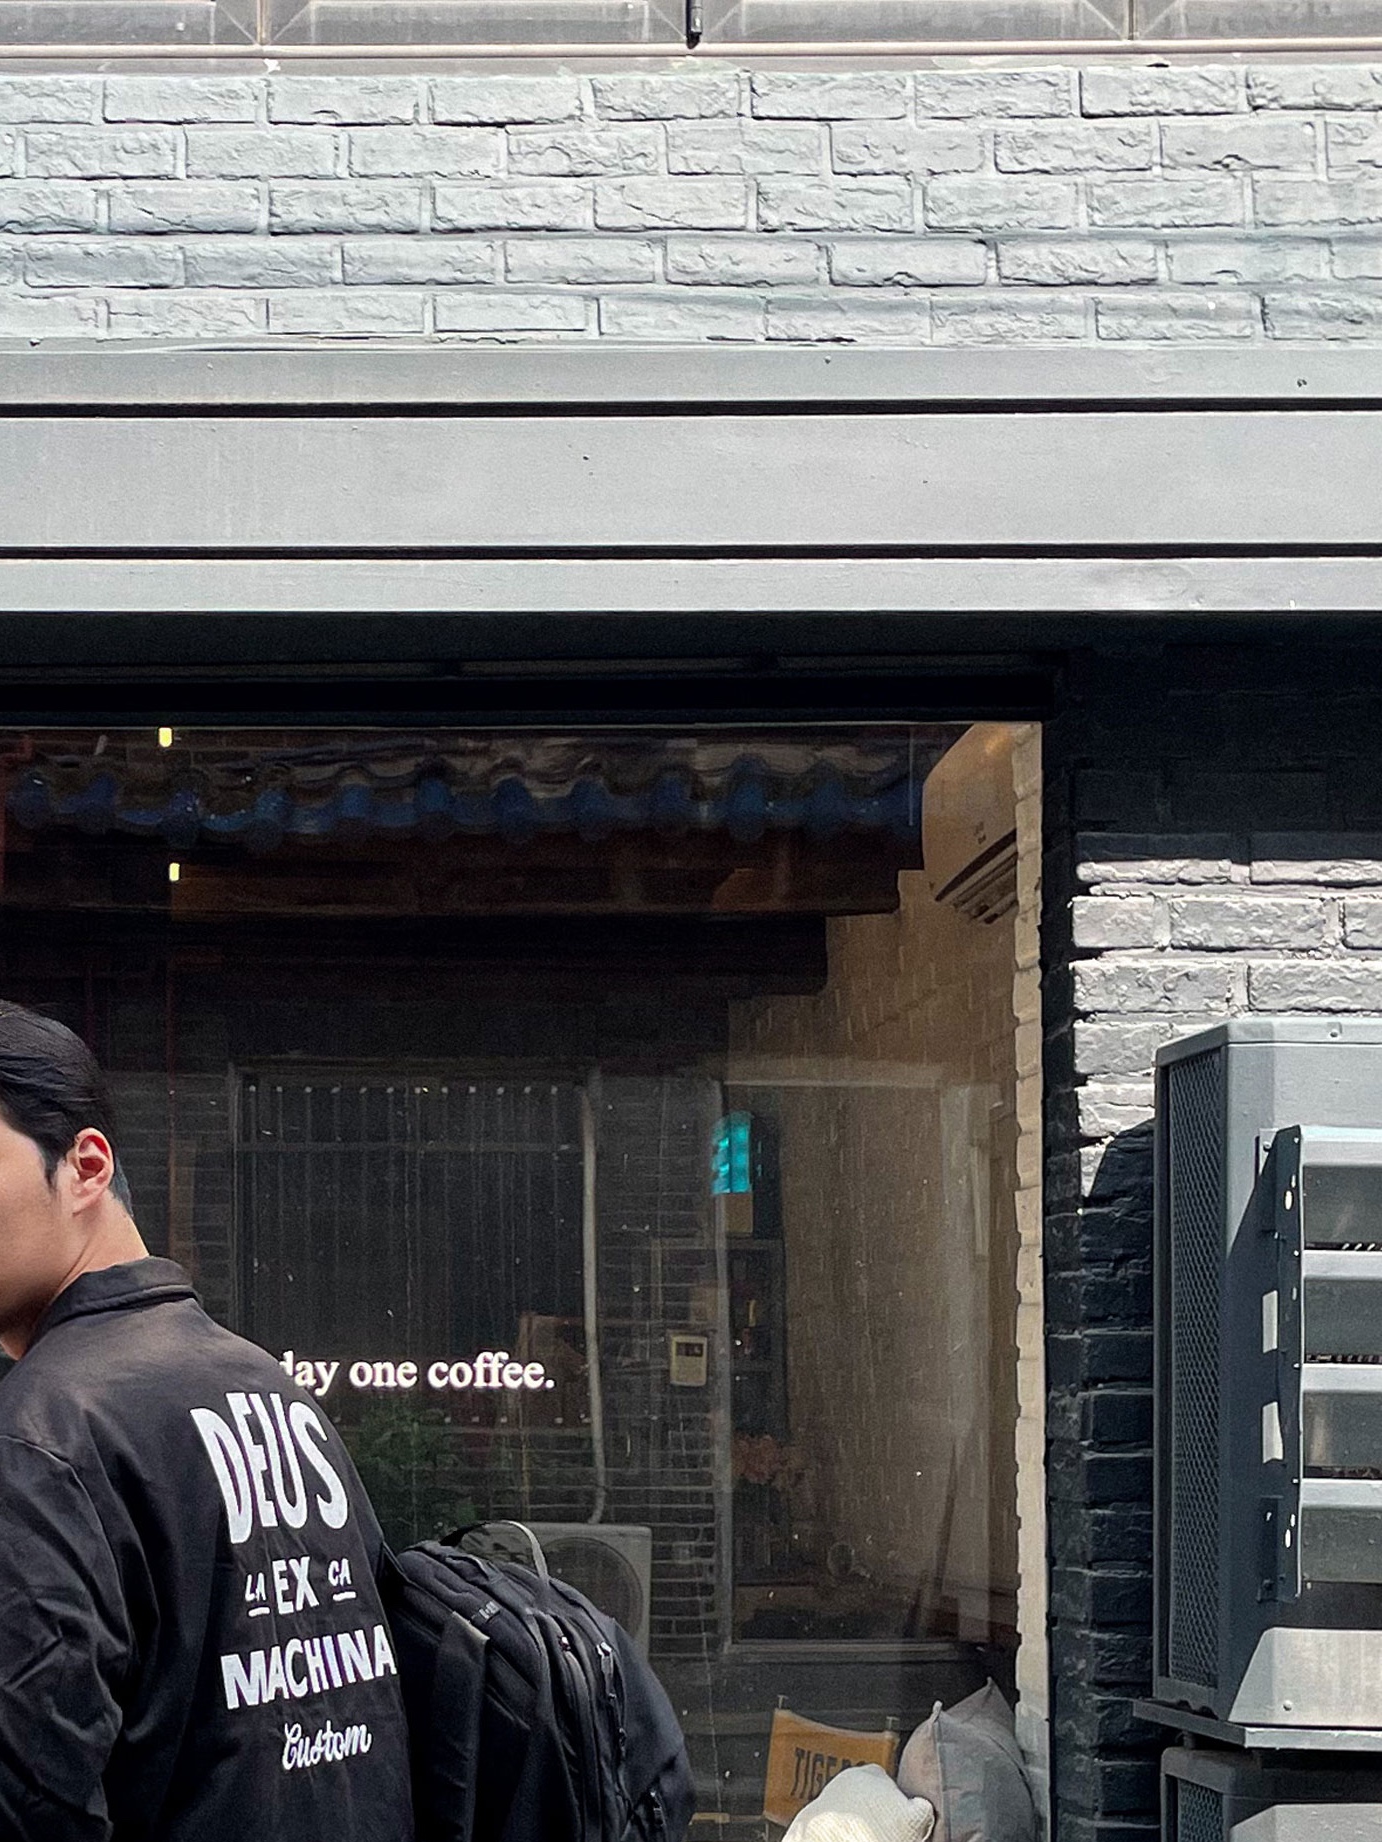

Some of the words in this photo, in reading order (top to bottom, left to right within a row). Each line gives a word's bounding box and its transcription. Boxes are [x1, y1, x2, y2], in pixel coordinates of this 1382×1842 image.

[349, 1361, 418, 1387] one
[427, 1351, 555, 1388] coffee.
[190, 1392, 348, 1544] DEUS
[245, 1572, 267, 1602] LA
[272, 1556, 320, 1614] EX
[328, 1558, 352, 1586] CA
[220, 1625, 397, 1709] MACHINA
[281, 1720, 372, 1771] Custom
